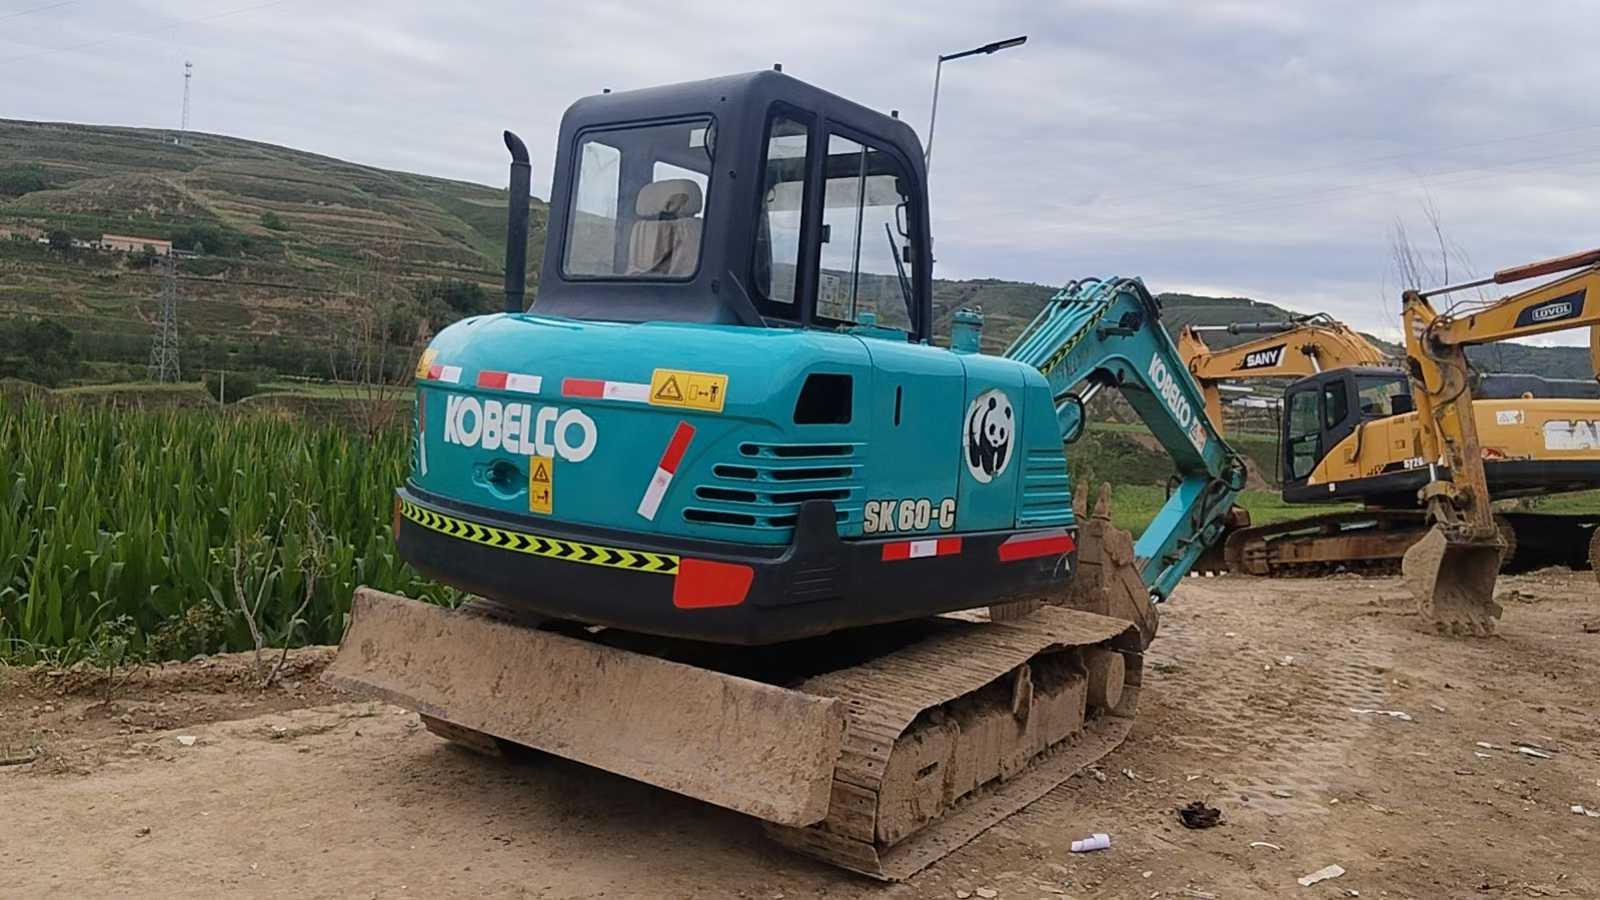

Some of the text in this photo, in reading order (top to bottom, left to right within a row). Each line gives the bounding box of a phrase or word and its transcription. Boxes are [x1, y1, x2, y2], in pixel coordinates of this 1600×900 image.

[1534, 303, 1570, 319] LOVOL
[1246, 350, 1279, 368] SANY
[1148, 351, 1191, 428] KOBELCO
[443, 395, 598, 463] KOBELCO
